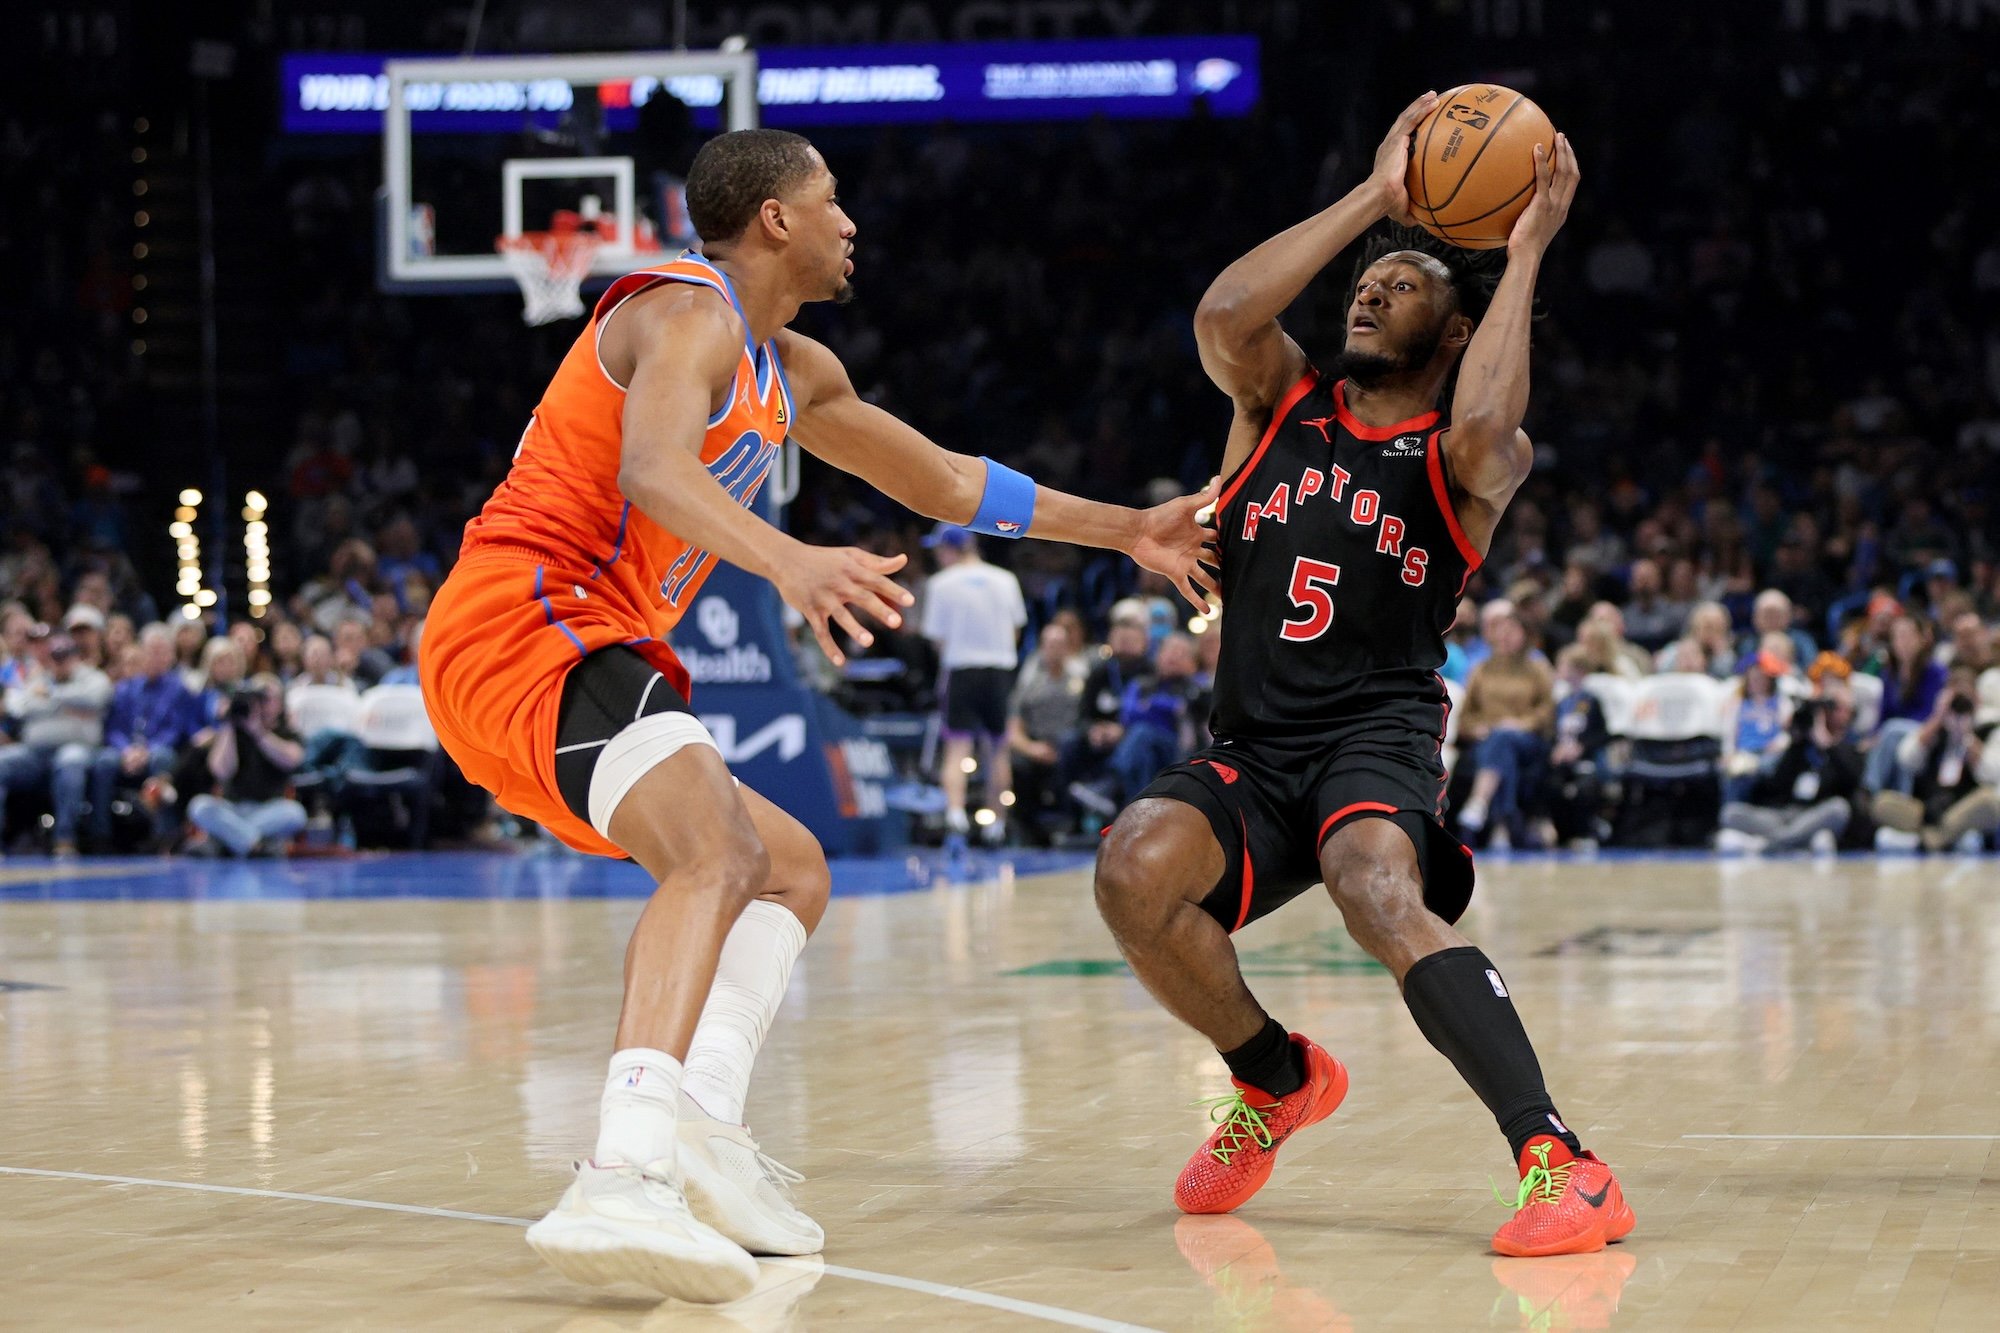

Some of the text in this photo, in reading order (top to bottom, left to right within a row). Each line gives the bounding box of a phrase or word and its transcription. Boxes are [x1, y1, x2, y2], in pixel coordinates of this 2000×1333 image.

[1382, 447, 1425, 457] Sun Life
[1242, 463, 1429, 587] RAPTORS
[697, 596, 739, 648] OU
[1279, 556, 1341, 642] 5
